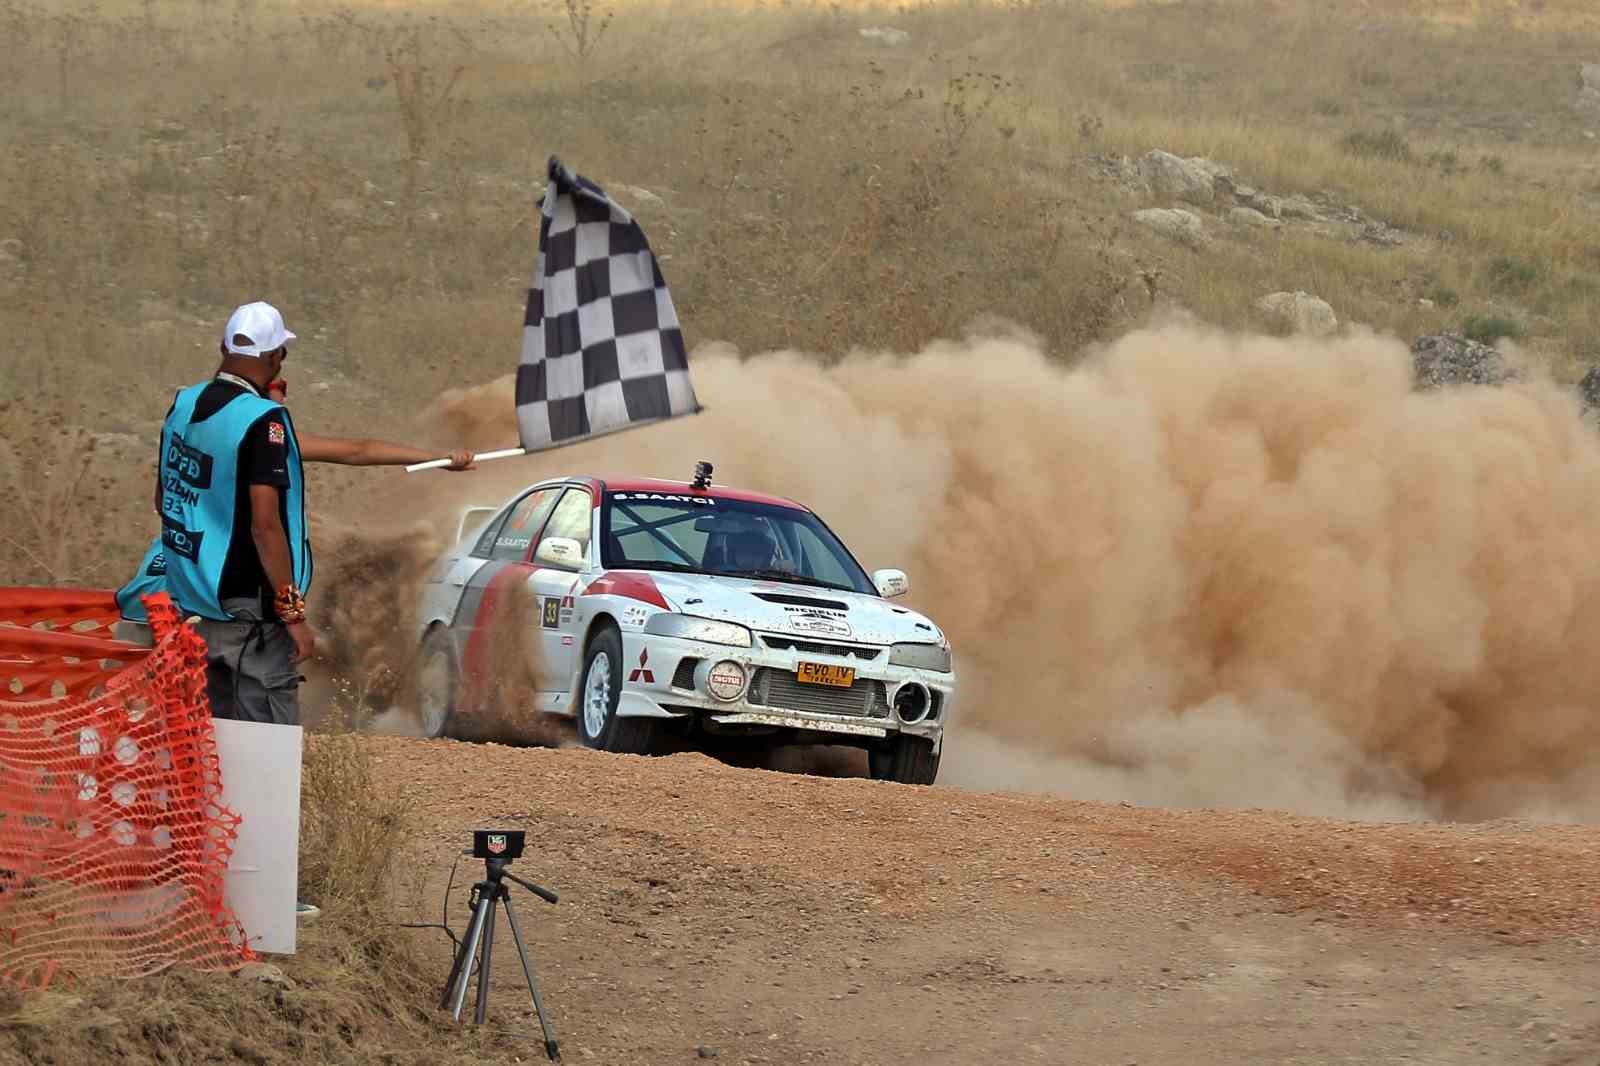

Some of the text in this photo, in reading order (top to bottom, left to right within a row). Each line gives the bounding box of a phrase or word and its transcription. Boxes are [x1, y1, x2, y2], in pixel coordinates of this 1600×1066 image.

[546, 601, 557, 623] 33
[783, 606, 847, 618] MICHELIN
[803, 662, 849, 679] EVO IV
